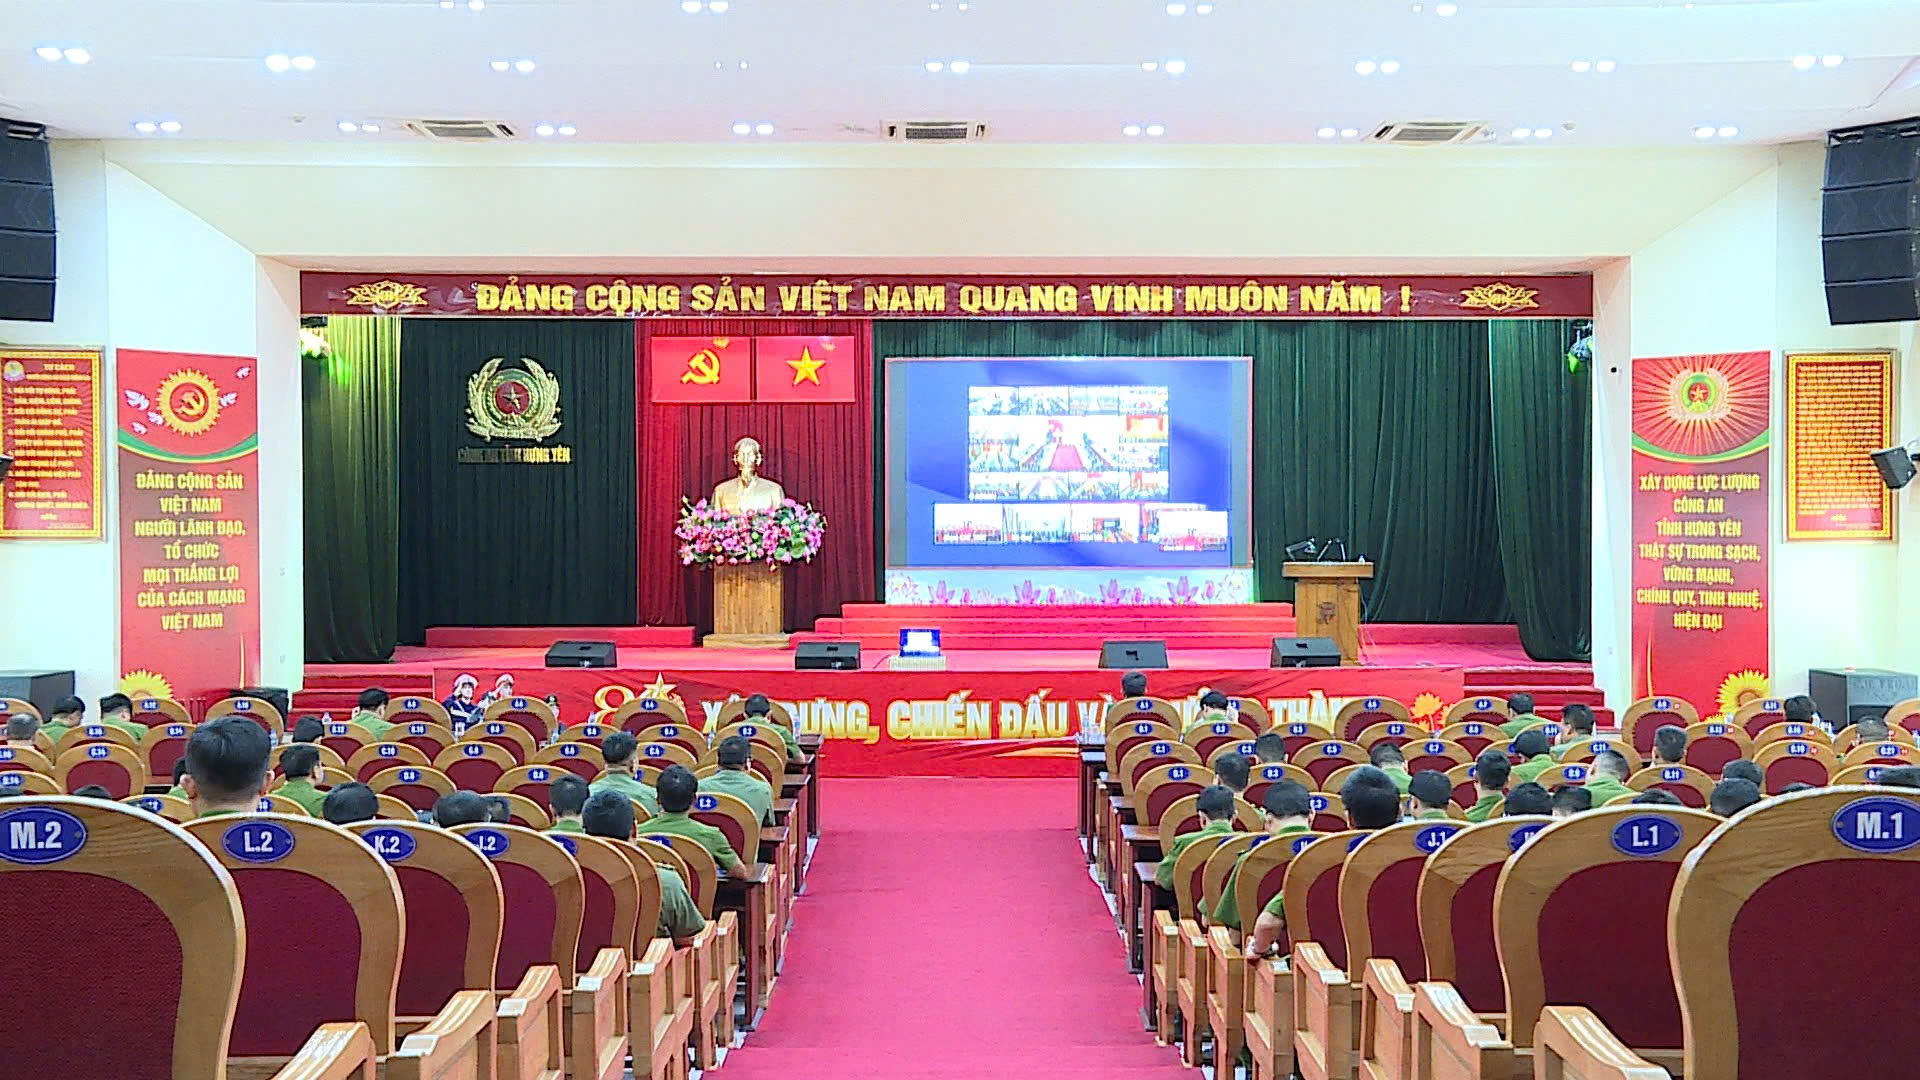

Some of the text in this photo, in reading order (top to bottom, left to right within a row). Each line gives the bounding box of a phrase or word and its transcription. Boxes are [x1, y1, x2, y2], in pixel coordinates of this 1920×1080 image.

[476, 276, 1411, 316] ĐẢNG CỘNG SẢN VIỆT NAM QUANG VINH MUÔN NĂM !
[523, 446, 549, 463] HƯNG
[551, 444, 570, 463] YÊN
[136, 469, 244, 492] ĐẢNG CỘNG SẢN
[1640, 472, 1760, 492] XÂY DỰNG LỰC LƯỢNG
[160, 494, 222, 515] VIỆT NAM
[1673, 495, 1723, 513] CÔNG AN
[134, 518, 246, 538] NGƯỜI LÃNH ĐẠO,
[1657, 517, 1741, 536] TỈNH HƯNG YÊN
[164, 539, 219, 559] TỔ CHỨC
[1639, 541, 1760, 563] THẬT SỰ TRONG SẠCH,
[144, 563, 239, 586] MỌI THẮNG LỢI
[1663, 565, 1734, 584] VỮNG MẠNH,
[138, 588, 245, 607] CỦA CÁCH MẠNG
[1637, 587, 1670, 603] CHÍNH
[1698, 591, 1725, 606] TINH
[162, 613, 223, 632] VIỆT NAM
[1673, 611, 1722, 631] HIỆN ĐẠI
[887, 689, 992, 740] CHIẾN
[997, 687, 1070, 738] ĐẤU
[10, 821, 62, 849] M.2
[1856, 812, 1903, 839] M.1
[244, 831, 273, 852] L.2
[374, 836, 400, 853] K.2
[1427, 831, 1446, 847] J.1
[1631, 825, 1659, 847] L.1
